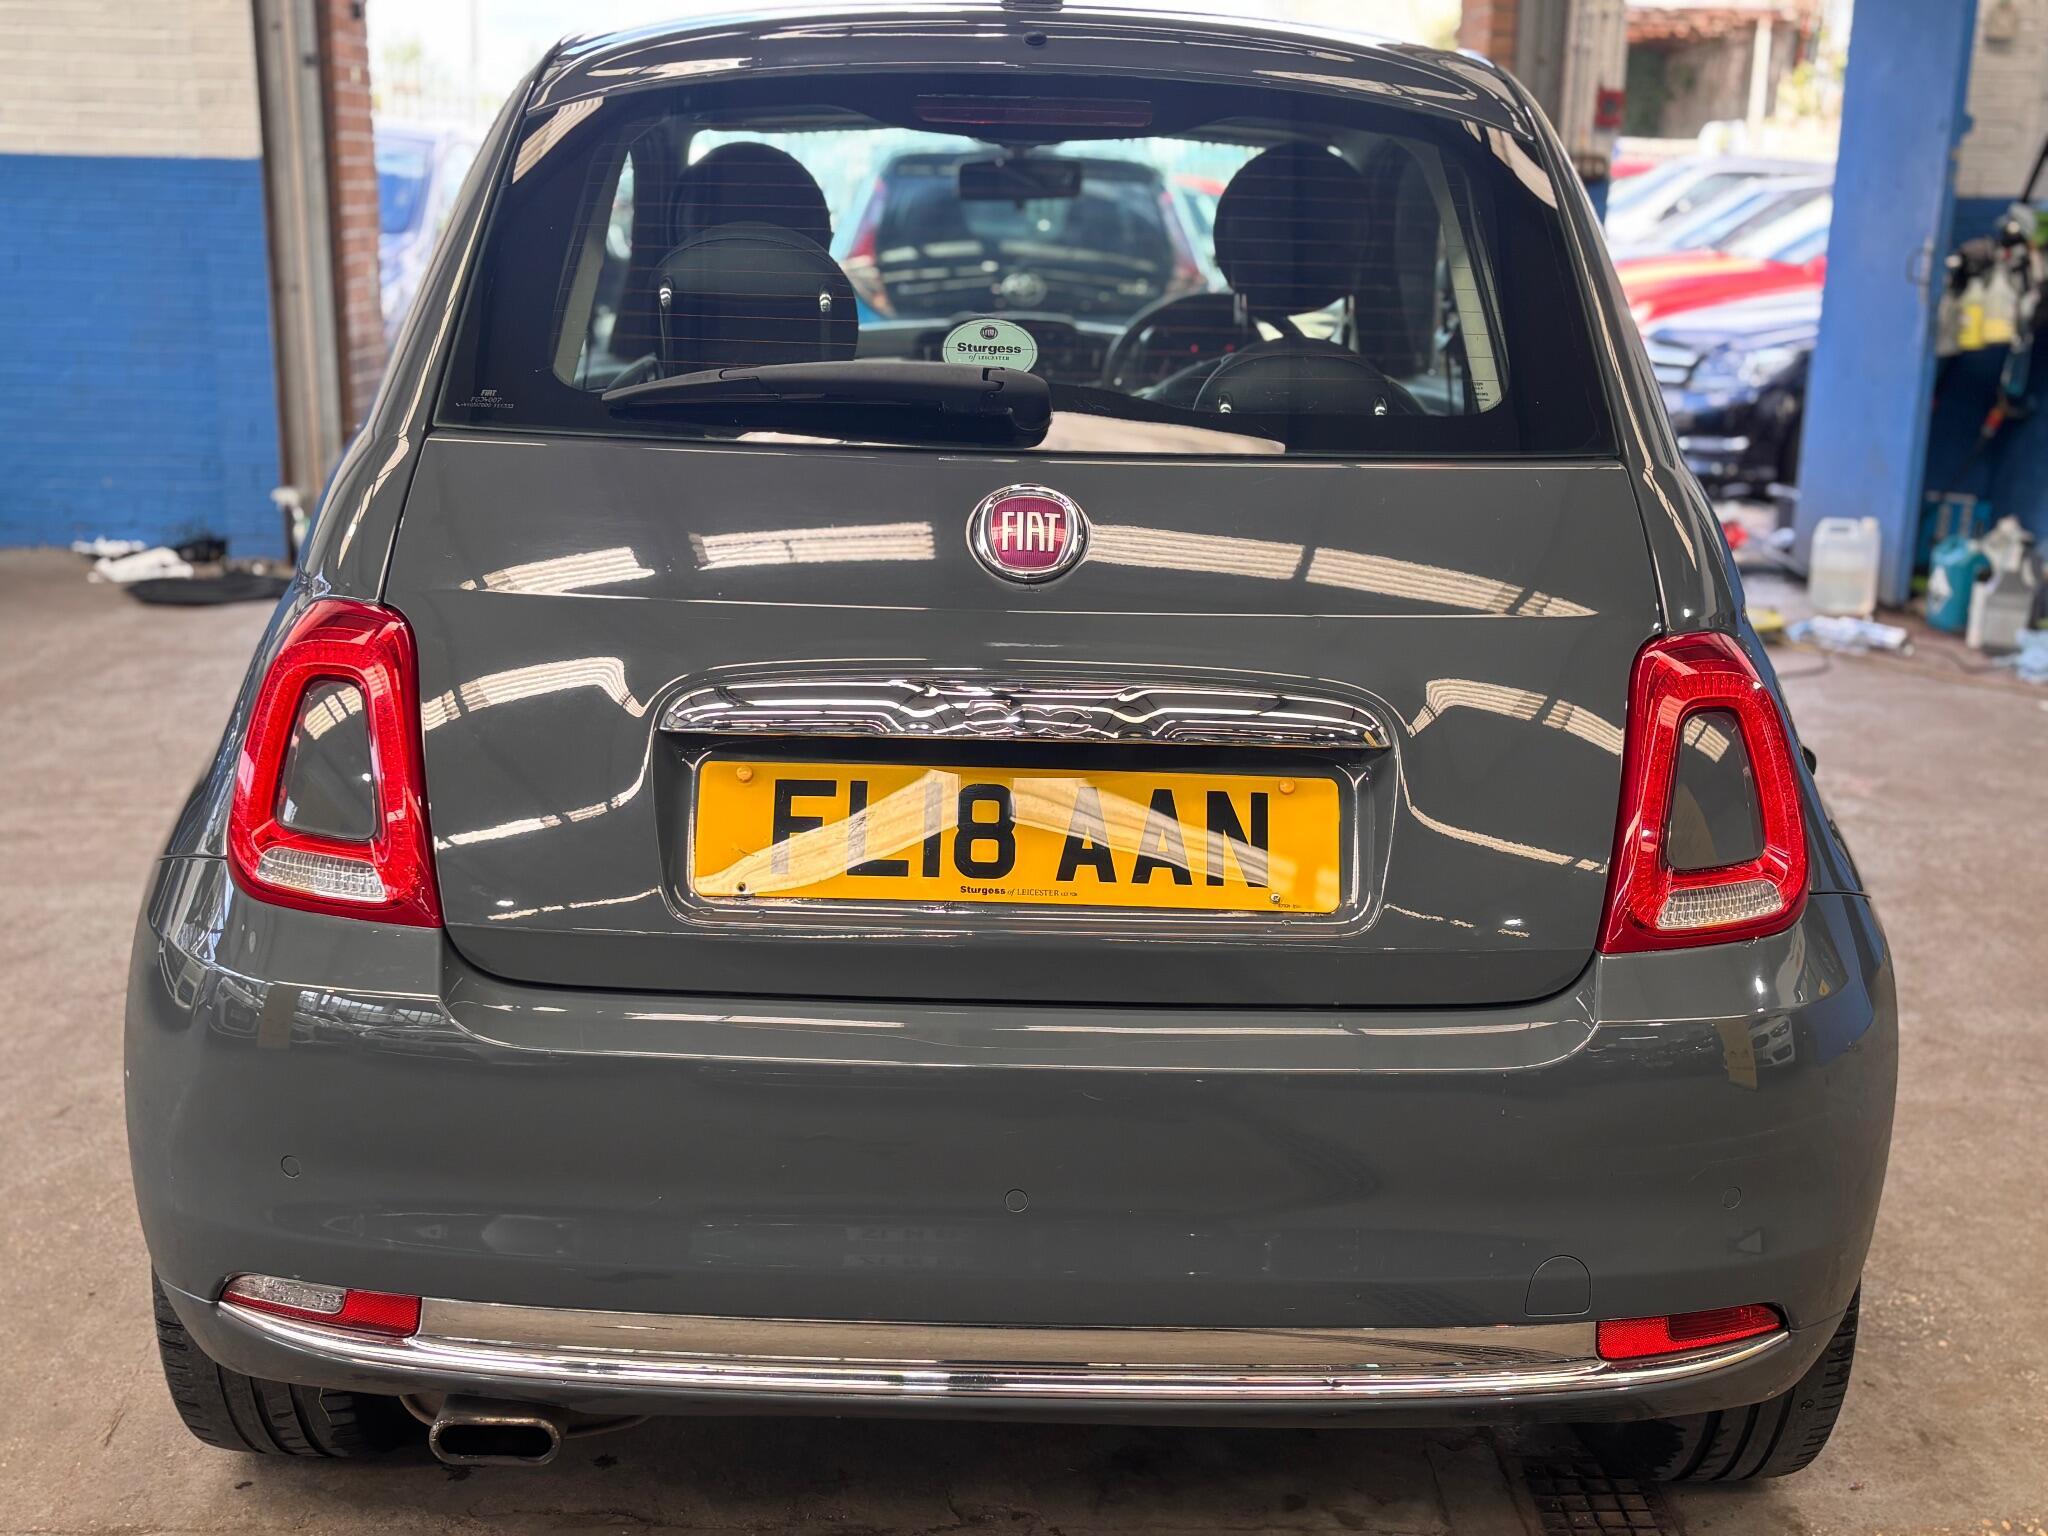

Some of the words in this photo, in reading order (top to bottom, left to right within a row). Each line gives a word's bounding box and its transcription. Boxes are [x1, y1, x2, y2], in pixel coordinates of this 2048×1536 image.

[957, 342, 1022, 354] Sturgess
[481, 389, 497, 397] FIAT
[1001, 511, 1061, 552] FIAT
[770, 779, 1017, 880] FL18
[1056, 786, 1269, 888] AAN
[960, 885, 1006, 896] Sturgess
[1017, 888, 1059, 897] LEICESTER
